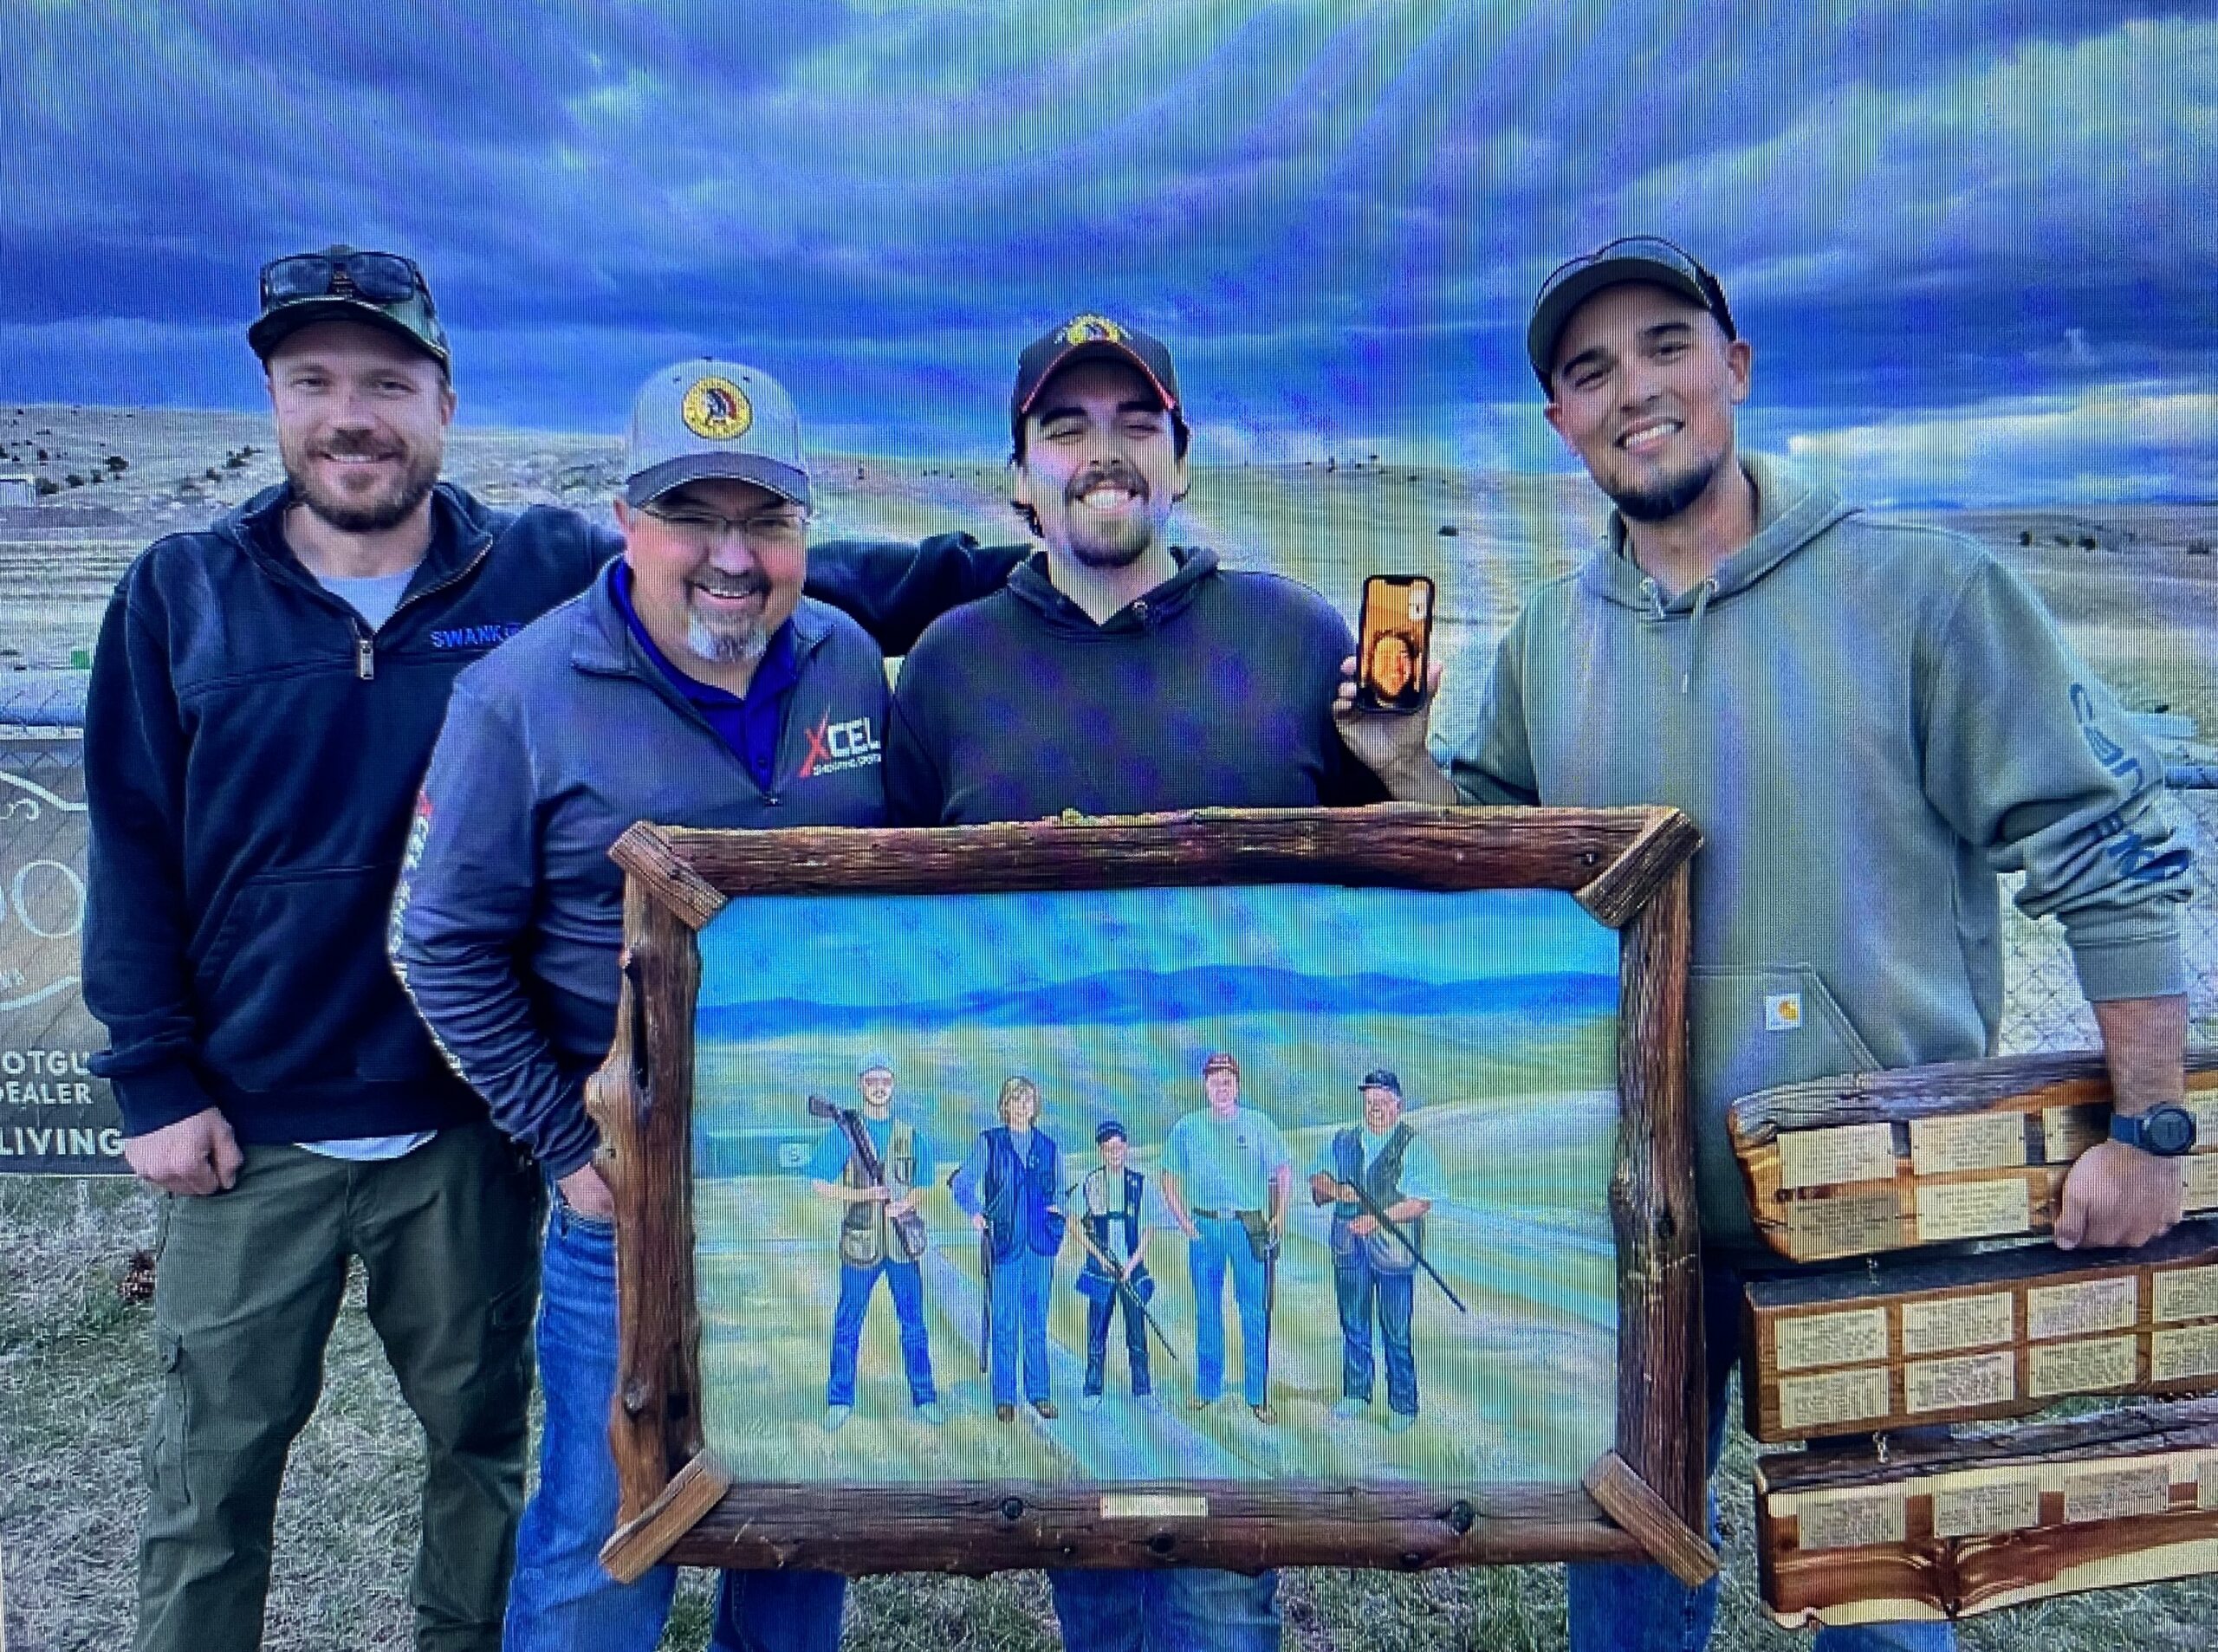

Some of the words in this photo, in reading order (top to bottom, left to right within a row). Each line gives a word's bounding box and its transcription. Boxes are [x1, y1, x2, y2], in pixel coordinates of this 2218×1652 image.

[799, 705, 881, 778] XCEL
[0, 860, 86, 938] O
[0, 1081, 94, 1105] EALER
[0, 1127, 125, 1156] LIVING
